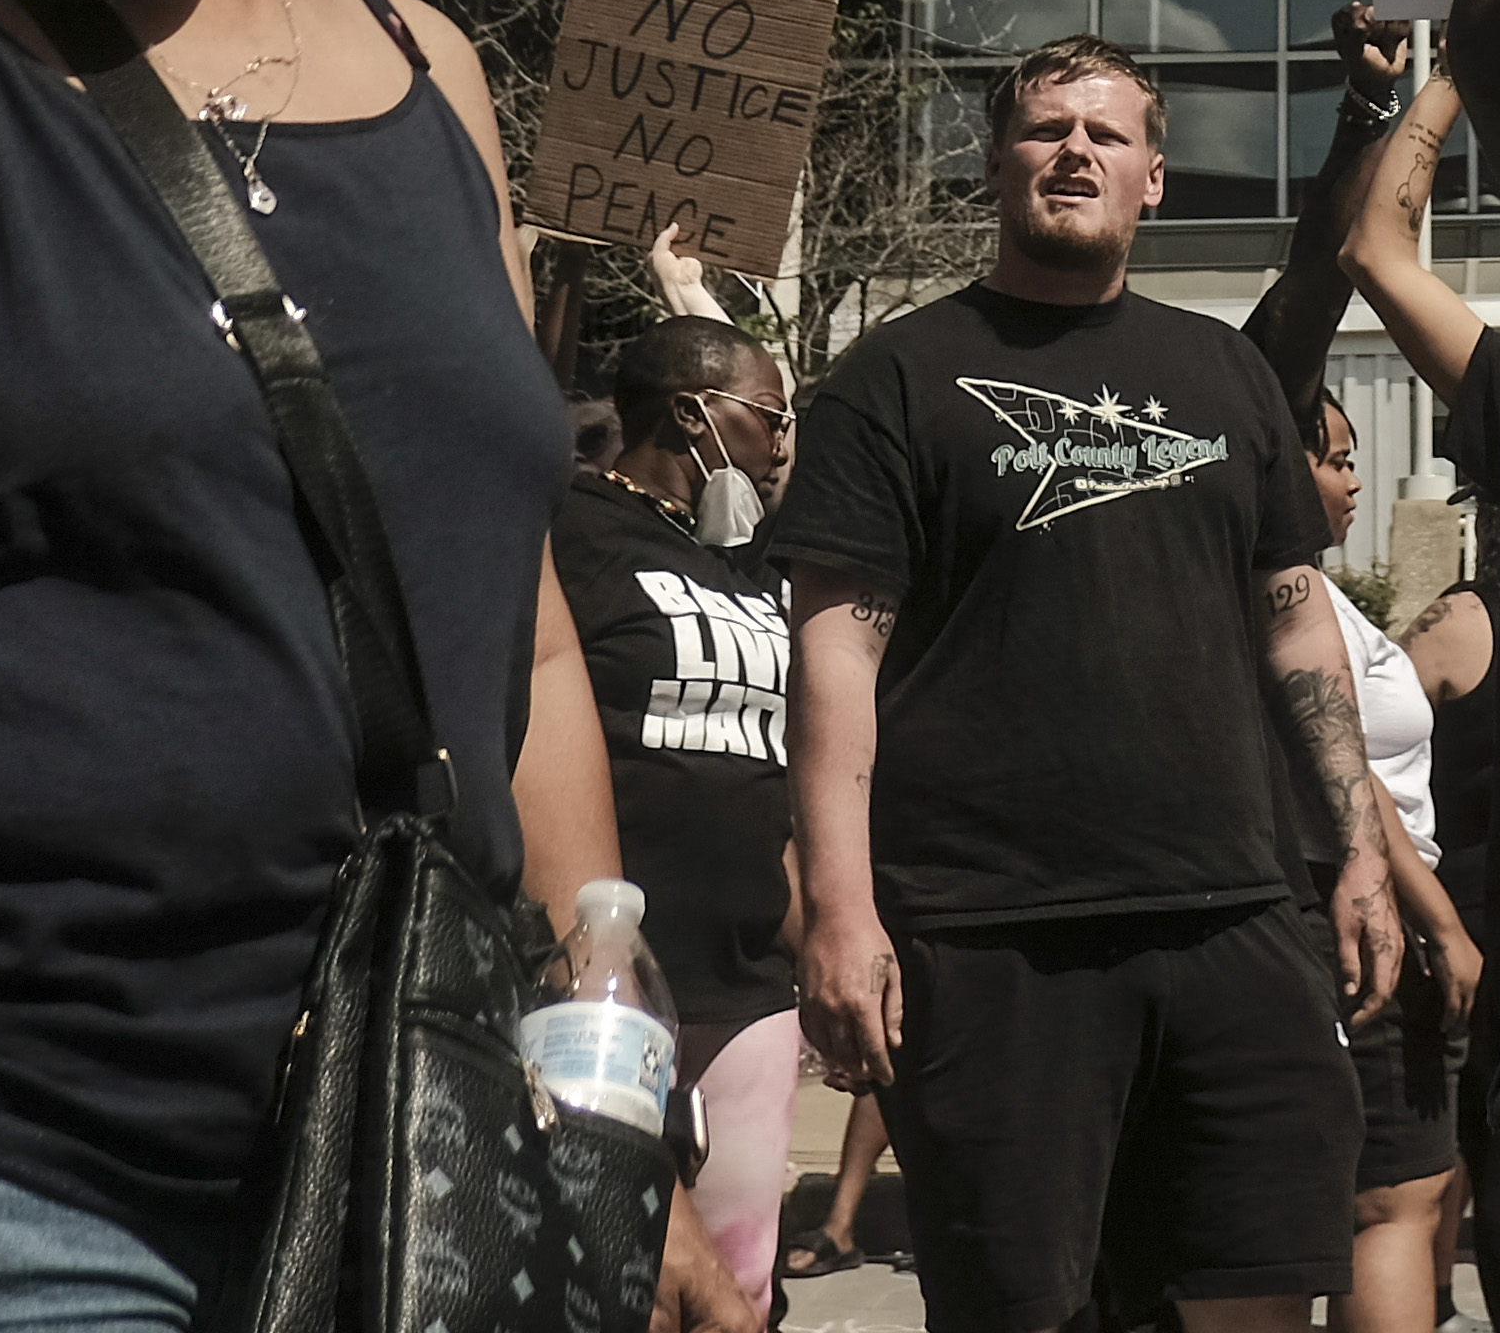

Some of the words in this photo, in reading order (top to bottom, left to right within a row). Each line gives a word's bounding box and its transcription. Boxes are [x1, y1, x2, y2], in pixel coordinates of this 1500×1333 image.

[562, 38, 812, 128] JUSTICE
[612, 113, 714, 177] NO
[564, 163, 736, 259] PEACE
[1054, 436, 1138, 481] County
[1141, 433, 1230, 472] Legend
[1266, 573, 1310, 617] 129
